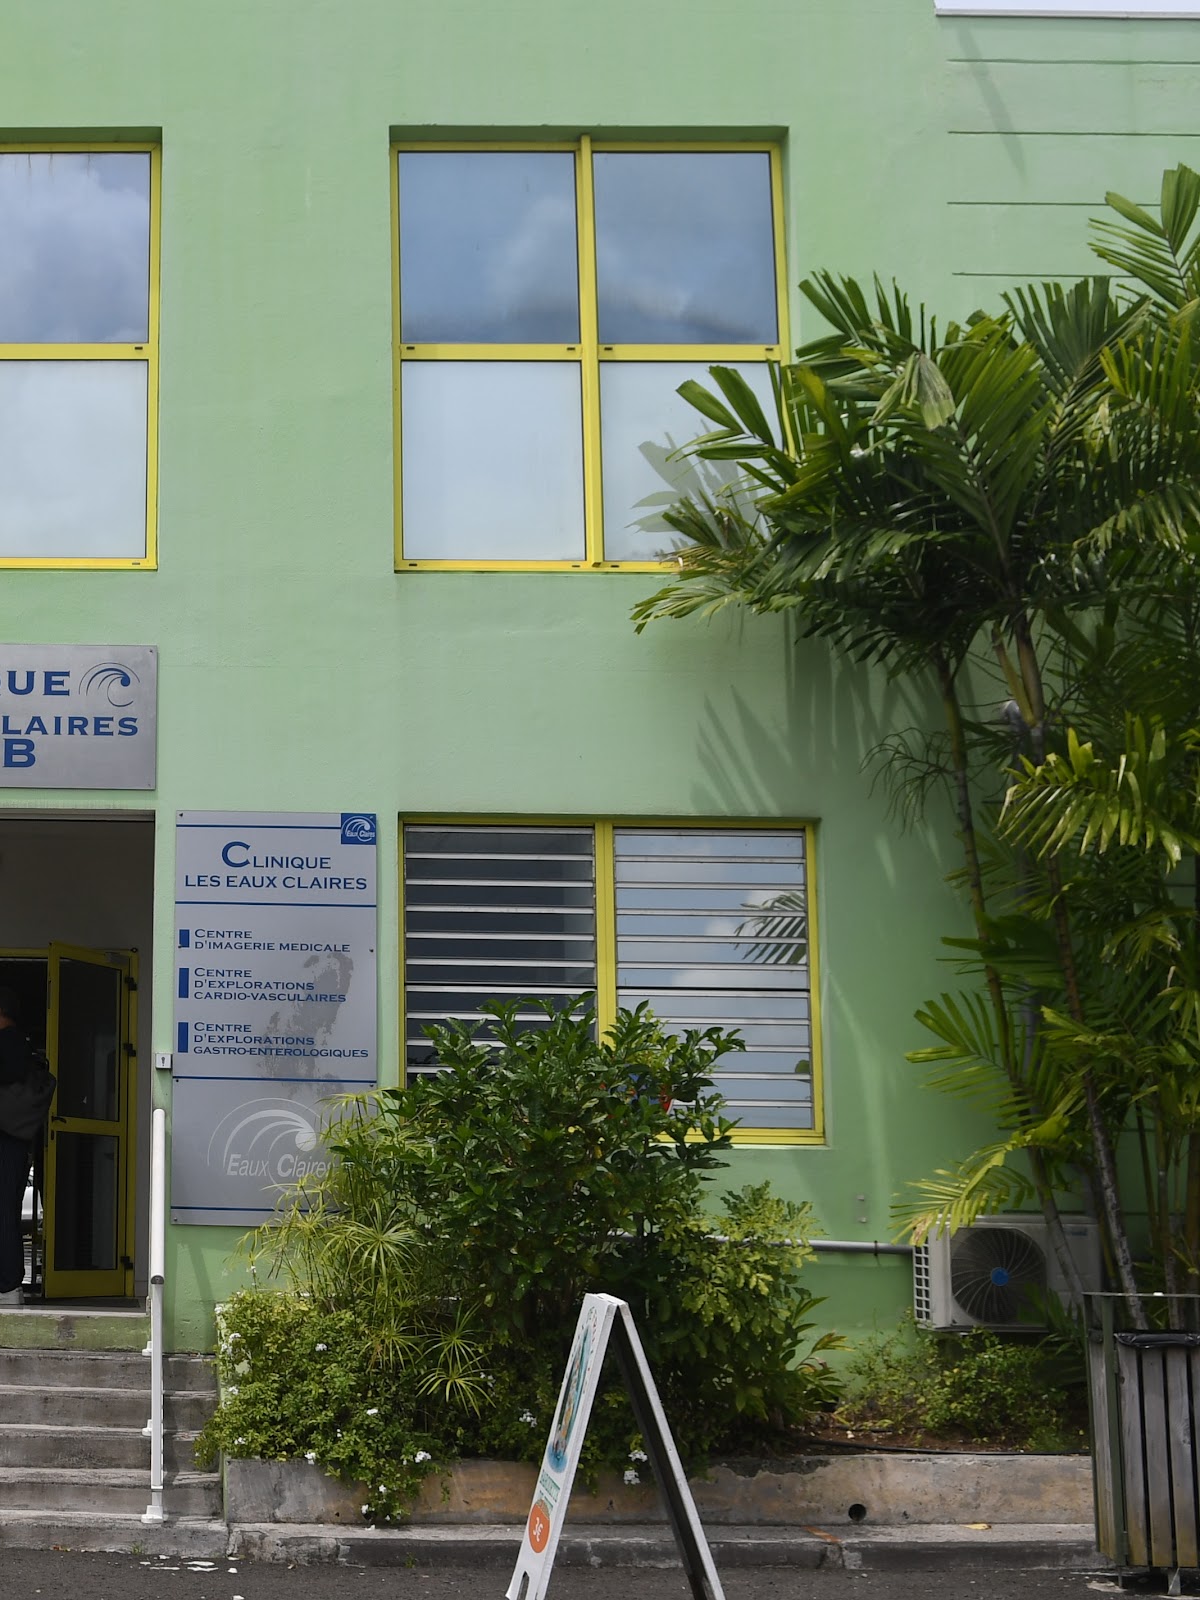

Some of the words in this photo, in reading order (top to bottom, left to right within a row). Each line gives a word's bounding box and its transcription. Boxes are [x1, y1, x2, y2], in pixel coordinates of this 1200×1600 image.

[4, 739, 36, 767] B
[221, 841, 331, 870] CLINIQUE
[185, 875, 221, 888] LES
[226, 876, 278, 889] EAUX
[282, 877, 368, 890] CLAIRES
[194, 929, 253, 939] CENTRE
[194, 940, 275, 951] D'IMAGERIE
[279, 943, 351, 953] MEDICALE
[194, 968, 253, 978] CENTRE
[194, 979, 315, 991] D'EXPLORATIONS
[194, 991, 347, 1003] CARDIO-VASCULAIRES
[194, 1022, 252, 1033] CENTRE
[194, 1033, 315, 1046] D'EXPLORATIONS
[193, 1046, 369, 1059] GASTRO-ENTEROLOGIQUES
[227, 1154, 269, 1176] Eaux
